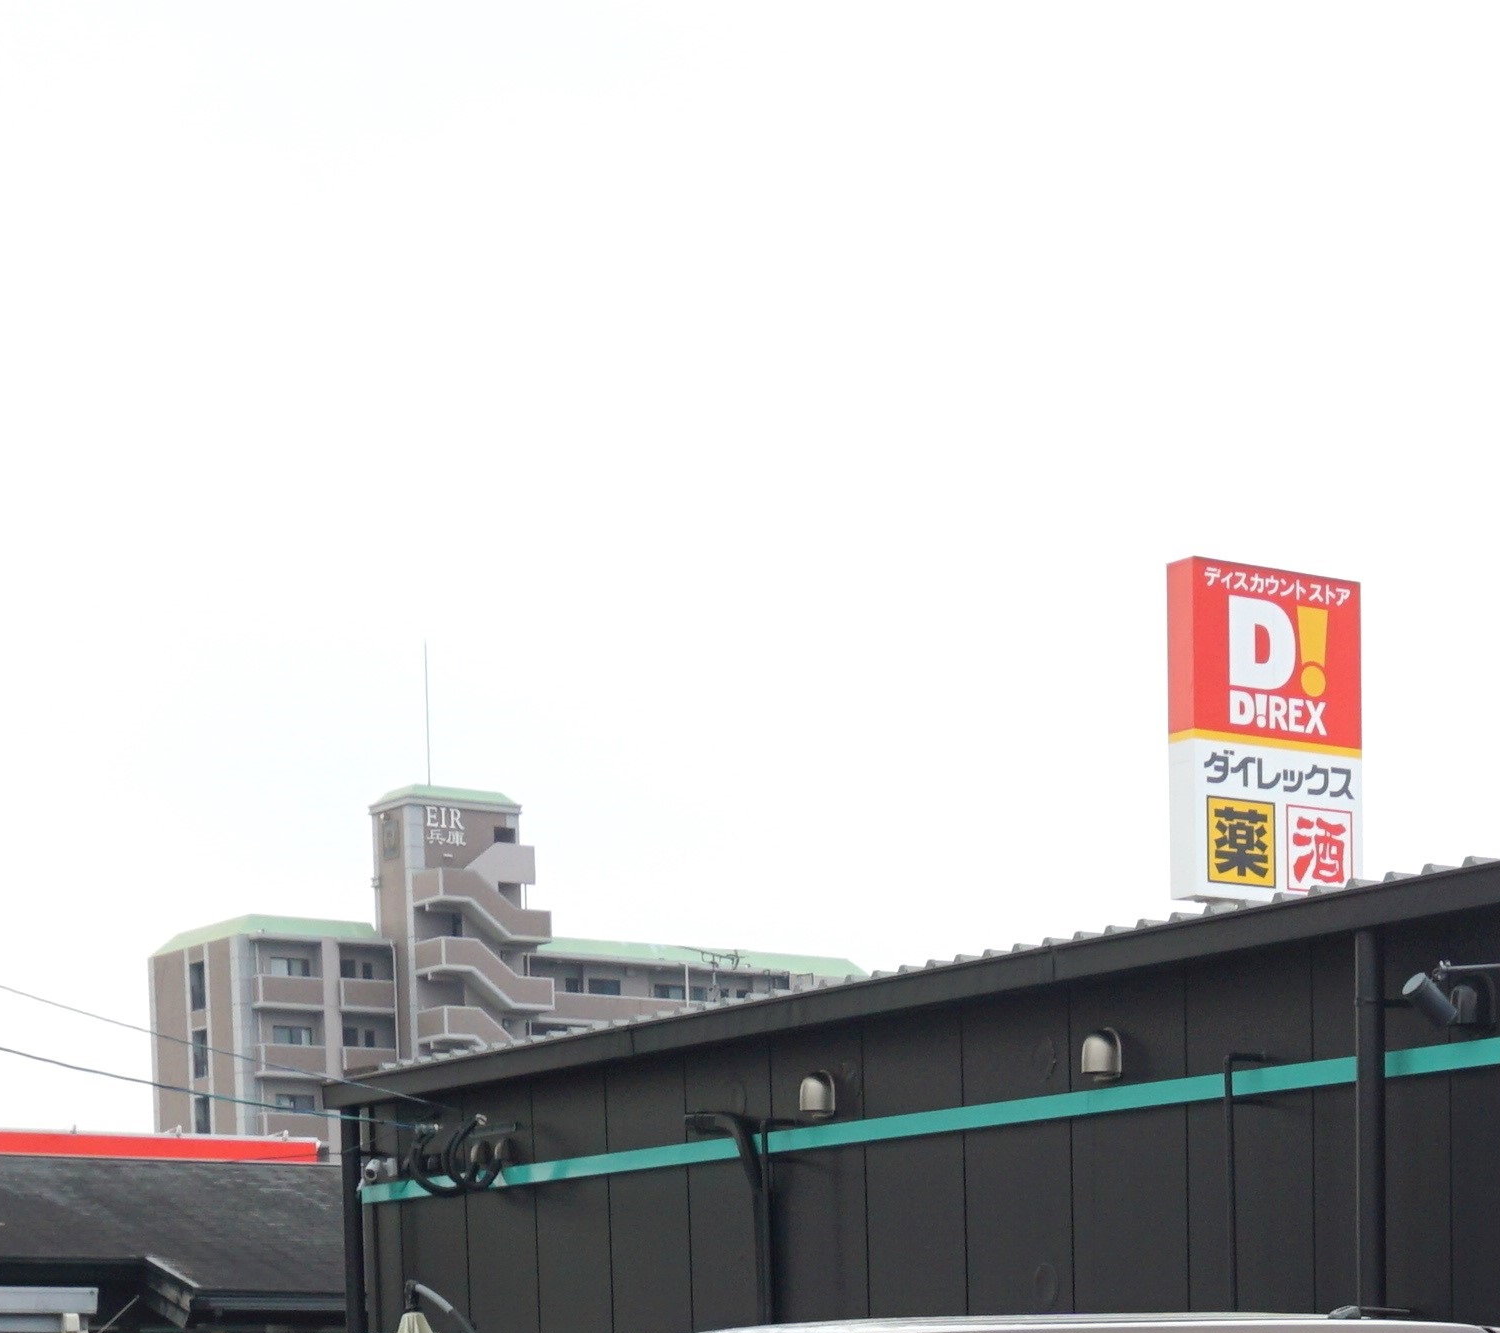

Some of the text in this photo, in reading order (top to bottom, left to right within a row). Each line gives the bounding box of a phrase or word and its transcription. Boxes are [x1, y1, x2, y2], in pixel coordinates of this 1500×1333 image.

[1204, 566, 1351, 606] ディスカウント ストア
[1204, 749, 1355, 800] ダイレックス
[425, 806, 465, 830] EIR
[426, 829, 467, 847] 兵庫
[1214, 806, 1269, 878] 薬
[1292, 816, 1347, 883] 酒
